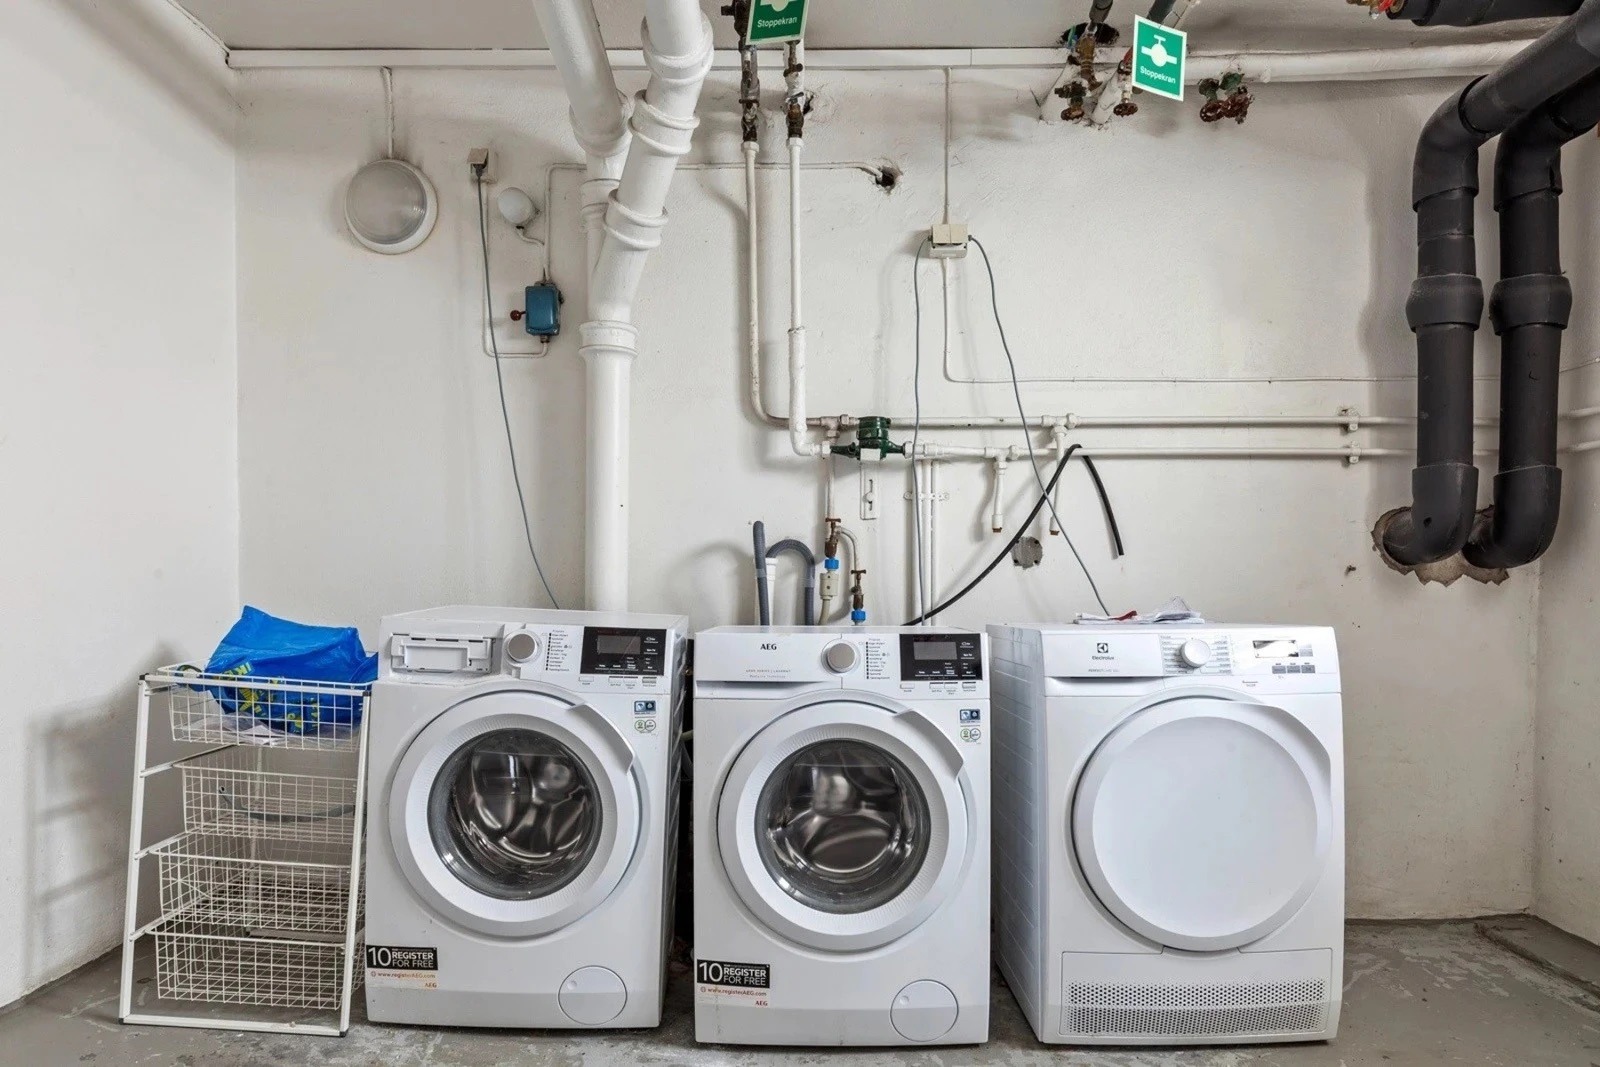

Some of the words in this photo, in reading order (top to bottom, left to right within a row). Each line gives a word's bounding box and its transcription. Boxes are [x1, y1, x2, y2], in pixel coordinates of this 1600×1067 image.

[757, 16, 798, 28] Stoppekran
[1140, 65, 1176, 84] Stoppekran
[760, 643, 777, 651] AEG
[368, 947, 391, 966] 10
[391, 951, 434, 960] REGISTER
[392, 959, 410, 967] FOR
[412, 960, 434, 968] FREE
[699, 962, 723, 982] 10
[723, 967, 767, 978] REGISTER
[723, 975, 741, 984] FOR
[743, 976, 766, 986] FREE
